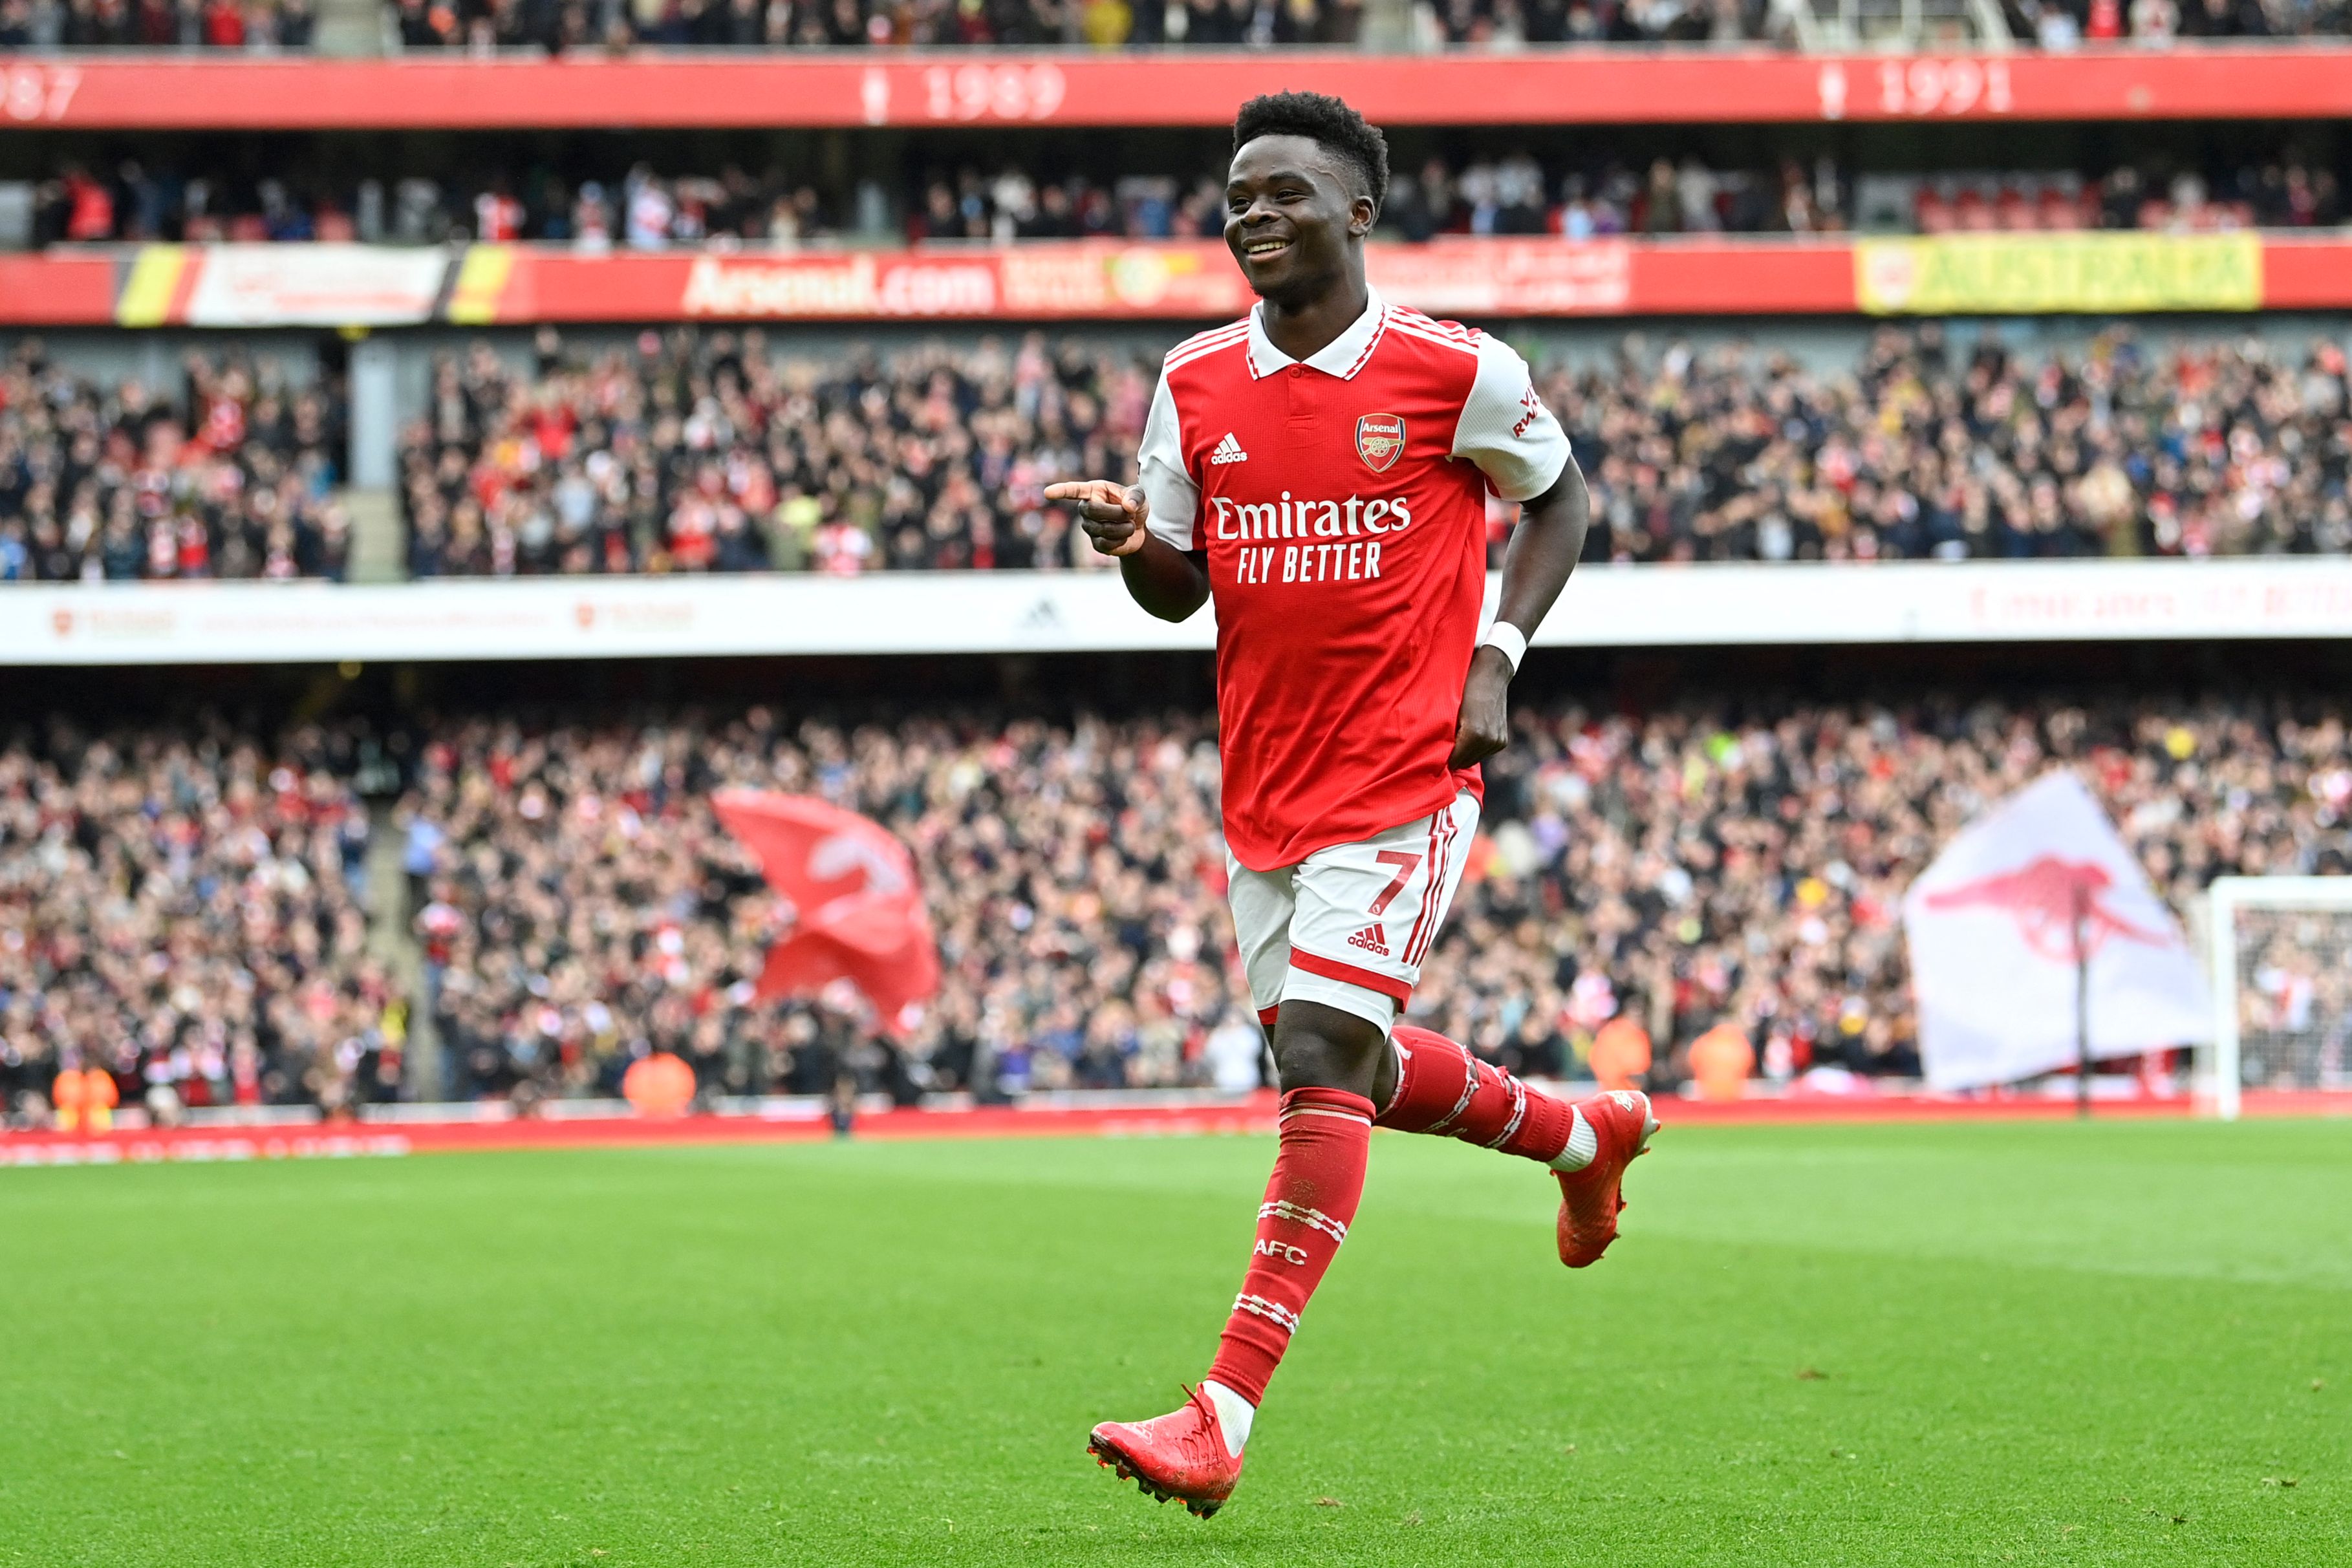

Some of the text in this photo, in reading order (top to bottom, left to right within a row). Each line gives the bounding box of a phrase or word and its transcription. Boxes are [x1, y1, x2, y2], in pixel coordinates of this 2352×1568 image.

[0, 67, 83, 121] 87
[922, 63, 1067, 120] 1989
[1877, 58, 2011, 115] 1991
[1362, 423, 1399, 433] Arsenal
[1211, 451, 1247, 465] adidas
[1211, 491, 1411, 540] Emirates
[1237, 542, 1381, 584] FLY BETTER
[1367, 850, 1423, 917] 7
[1347, 935, 1390, 957] adidas
[1253, 1238, 1308, 1266] AFC
